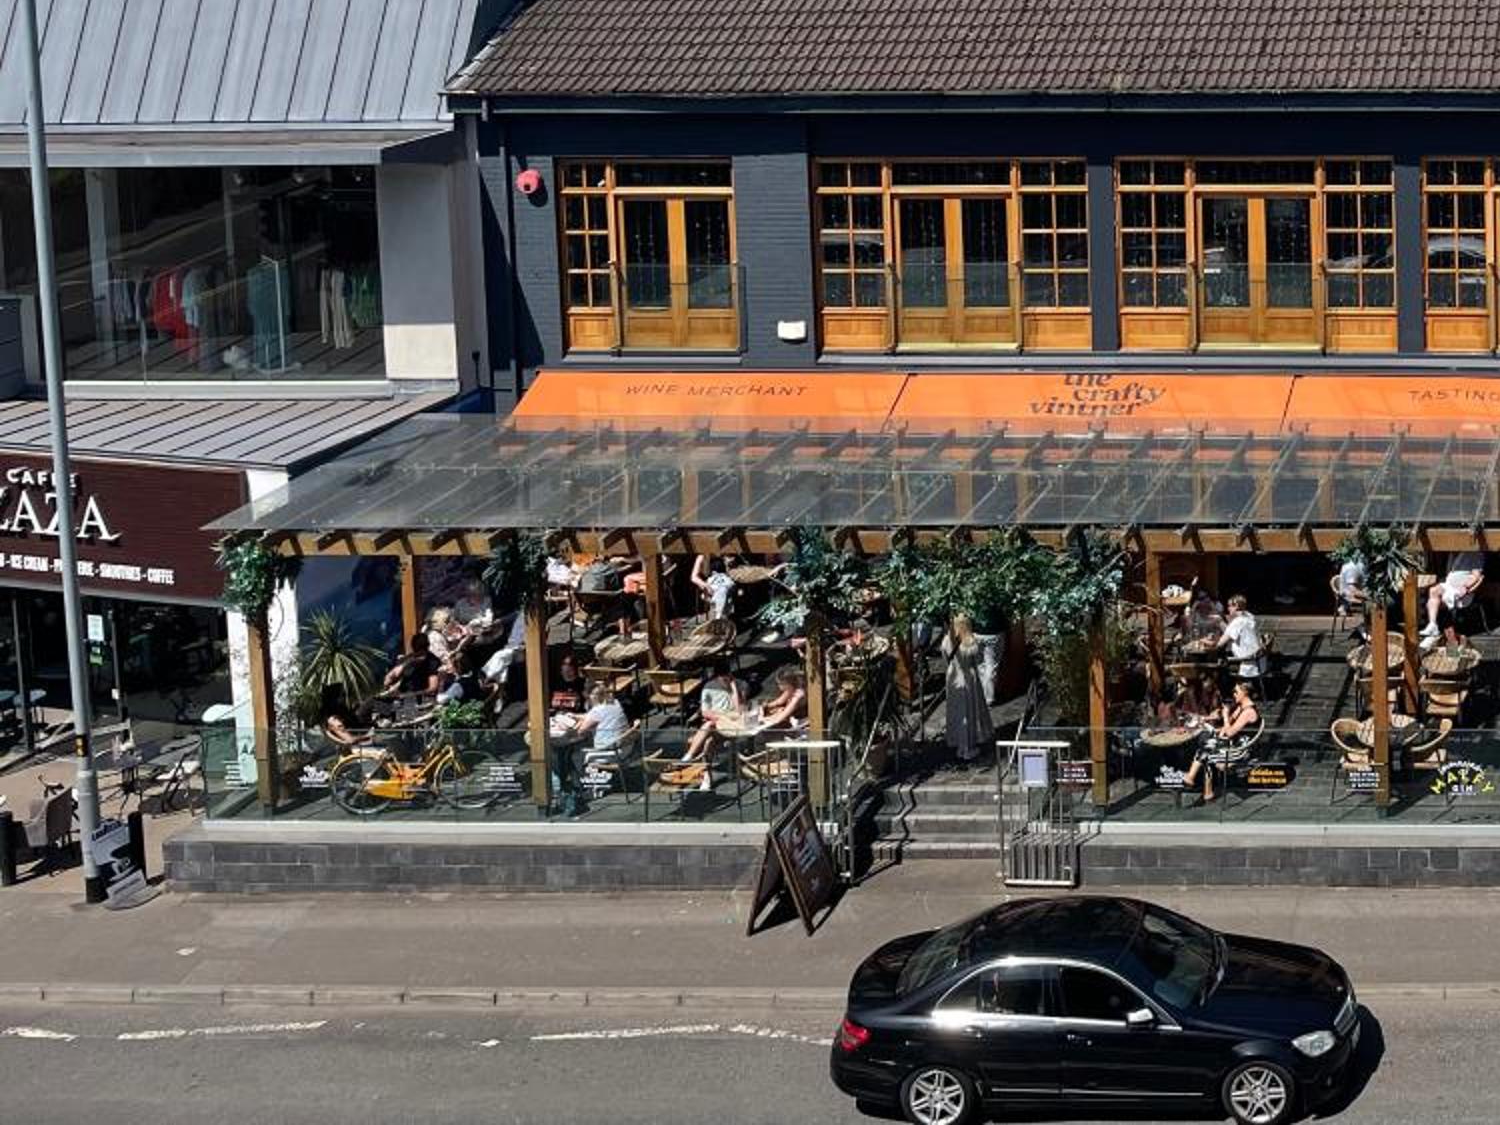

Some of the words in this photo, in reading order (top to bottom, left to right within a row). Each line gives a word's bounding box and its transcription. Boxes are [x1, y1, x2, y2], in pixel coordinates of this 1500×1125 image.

[626, 383, 680, 395] WINE
[687, 385, 808, 396] MERCHANT
[1408, 388, 1500, 402] TASTING
[1030, 397, 1141, 415] vintner
[147, 567, 175, 585] COFFEE
